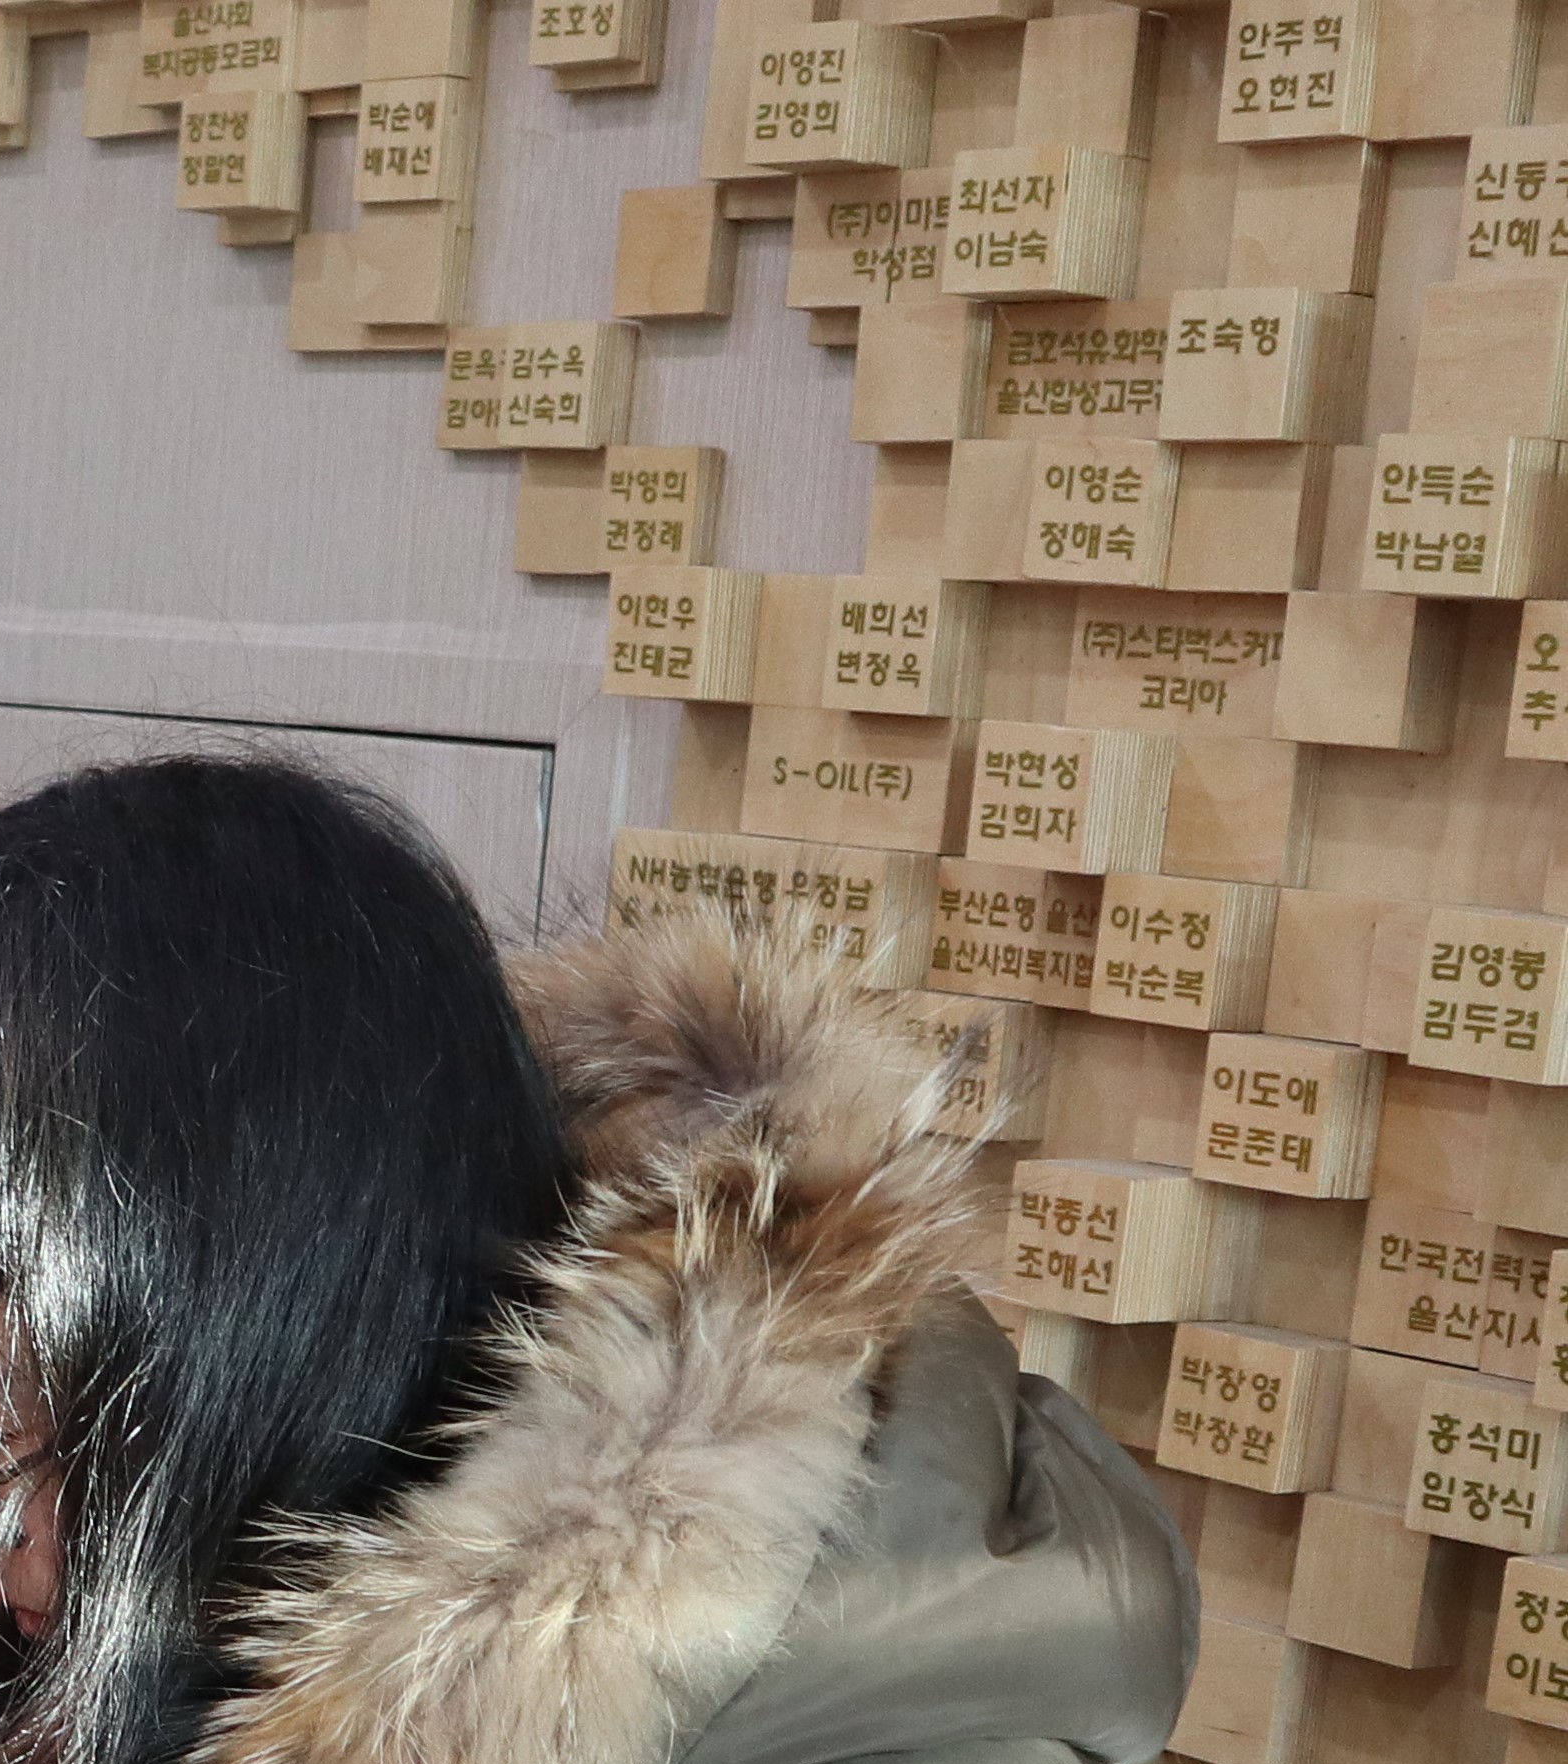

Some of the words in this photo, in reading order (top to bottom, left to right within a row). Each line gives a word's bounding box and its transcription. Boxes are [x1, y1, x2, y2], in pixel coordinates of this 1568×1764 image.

[539, 3, 614, 37] 조호성
[1239, 15, 1343, 61] 안주혁
[761, 49, 845, 86] 이영진
[1232, 69, 1336, 114] 오현진
[756, 100, 839, 140] 김영희
[959, 176, 1055, 213] 최선자
[853, 246, 937, 282] 학성점
[955, 228, 1048, 268] 이남숙
[1008, 329, 1167, 365] 금호석유화학
[1176, 316, 1280, 356] 조숙형
[451, 349, 506, 380] 문옥
[513, 345, 584, 379] 김수옥
[509, 392, 581, 425] 신숙희
[609, 470, 686, 502] 박영희
[1046, 465, 1141, 503] 이영순
[1383, 464, 1493, 506] 안득순
[606, 519, 683, 552] 권정례
[1040, 521, 1135, 560] 정해숙
[1376, 531, 1486, 574] 박남열
[842, 602, 928, 638] 배희선
[613, 645, 693, 680] 진태균
[837, 651, 921, 687] 변정옥
[1140, 675, 1226, 715] 코리아
[772, 756, 913, 801] S-OIL(주)
[985, 751, 1079, 790] 박현성
[980, 804, 1077, 843] 김희자
[939, 888, 1035, 931] 부산은행
[1110, 903, 1210, 949] 이수정
[1105, 960, 1205, 1006] 박순복
[1431, 942, 1546, 991] 김영봉
[1213, 1067, 1319, 1115] 이도애
[1207, 1121, 1313, 1173] 문준태
[1016, 1244, 1112, 1296] 조해선
[1181, 1356, 1281, 1413] 박장영
[1427, 1413, 1541, 1470] 홍석미
[1422, 1472, 1535, 1530] 임장식
